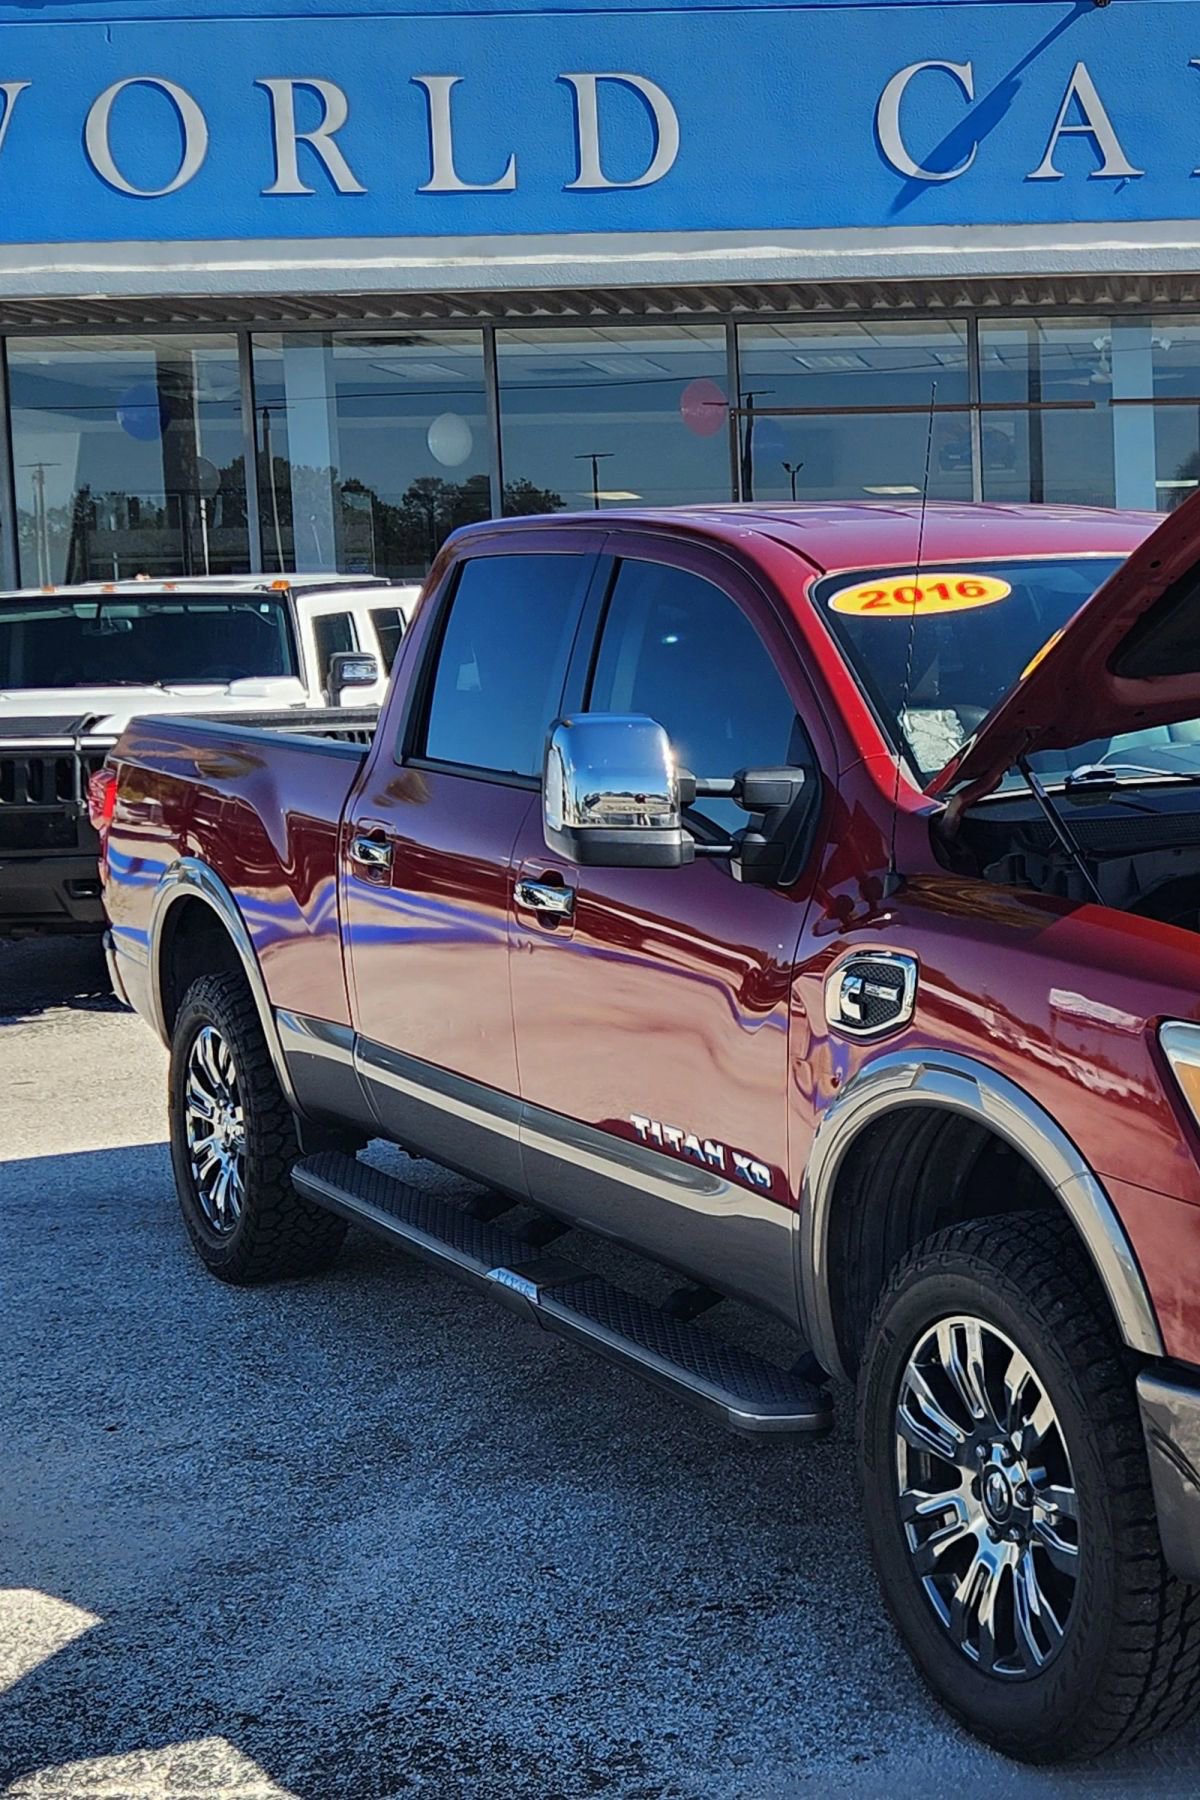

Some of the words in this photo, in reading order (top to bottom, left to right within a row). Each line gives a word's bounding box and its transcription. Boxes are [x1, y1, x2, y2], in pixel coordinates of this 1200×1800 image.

[857, 580, 988, 610] 2016
[630, 1113, 726, 1170] TITAN
[732, 1151, 773, 1188] XD
